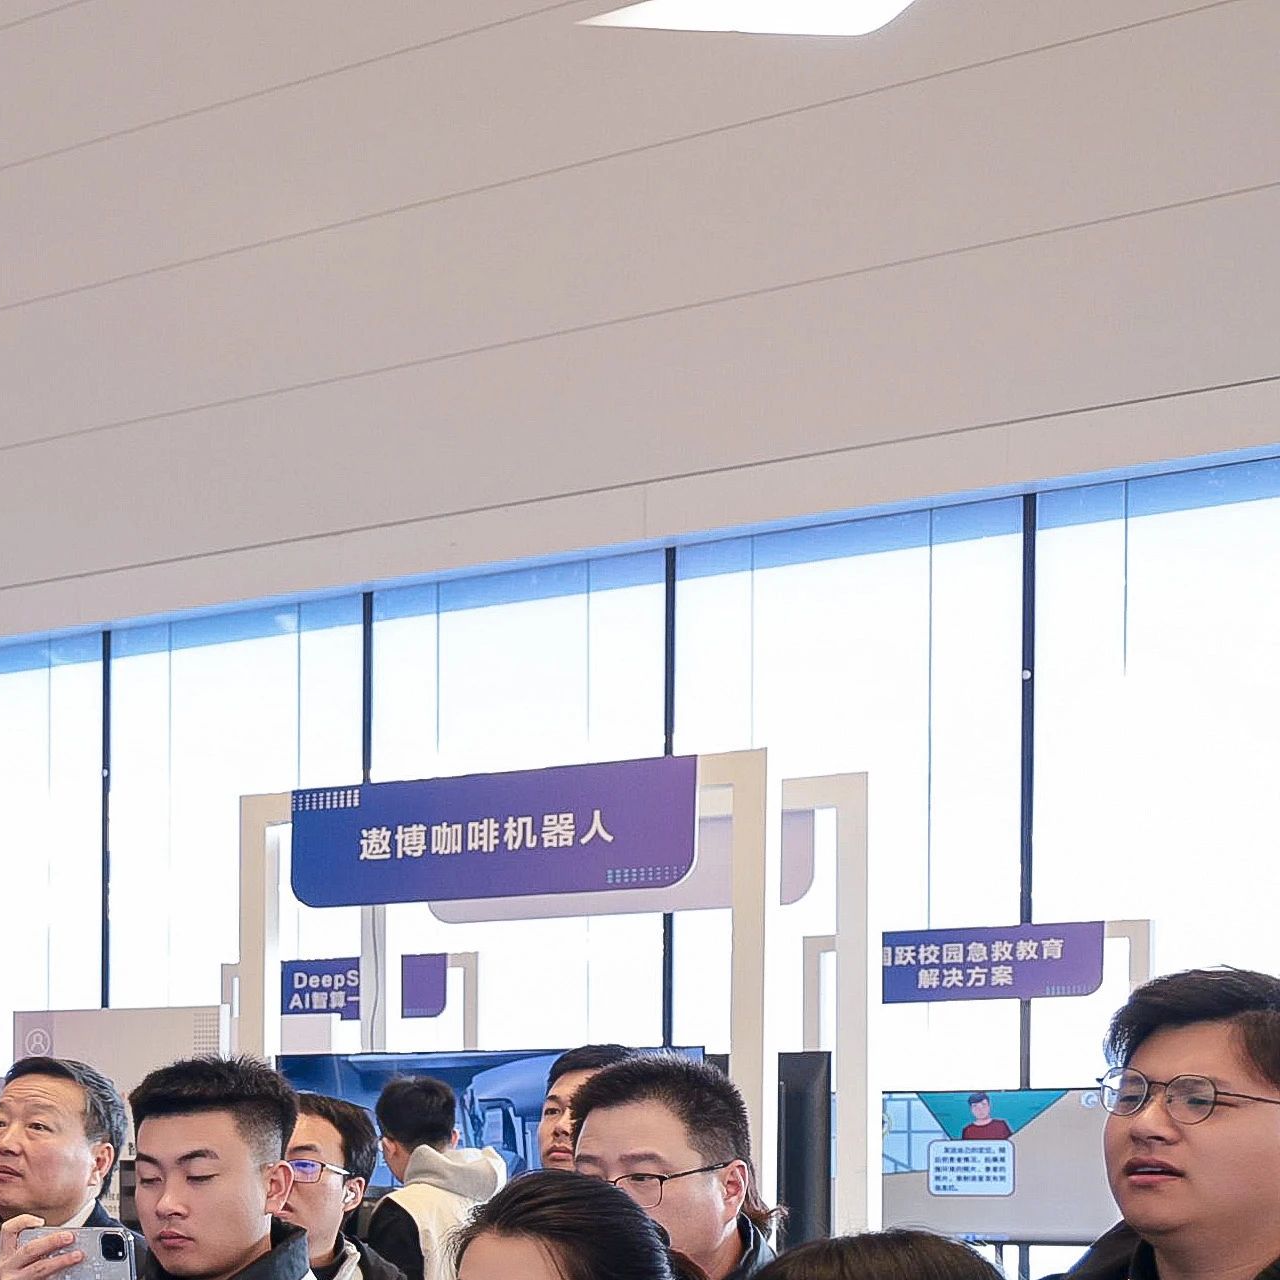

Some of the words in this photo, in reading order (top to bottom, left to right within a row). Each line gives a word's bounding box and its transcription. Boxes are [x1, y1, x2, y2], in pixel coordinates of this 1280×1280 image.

[358, 808, 615, 861] 遨博咖啡机器人
[917, 966, 1014, 989] 解决方案
